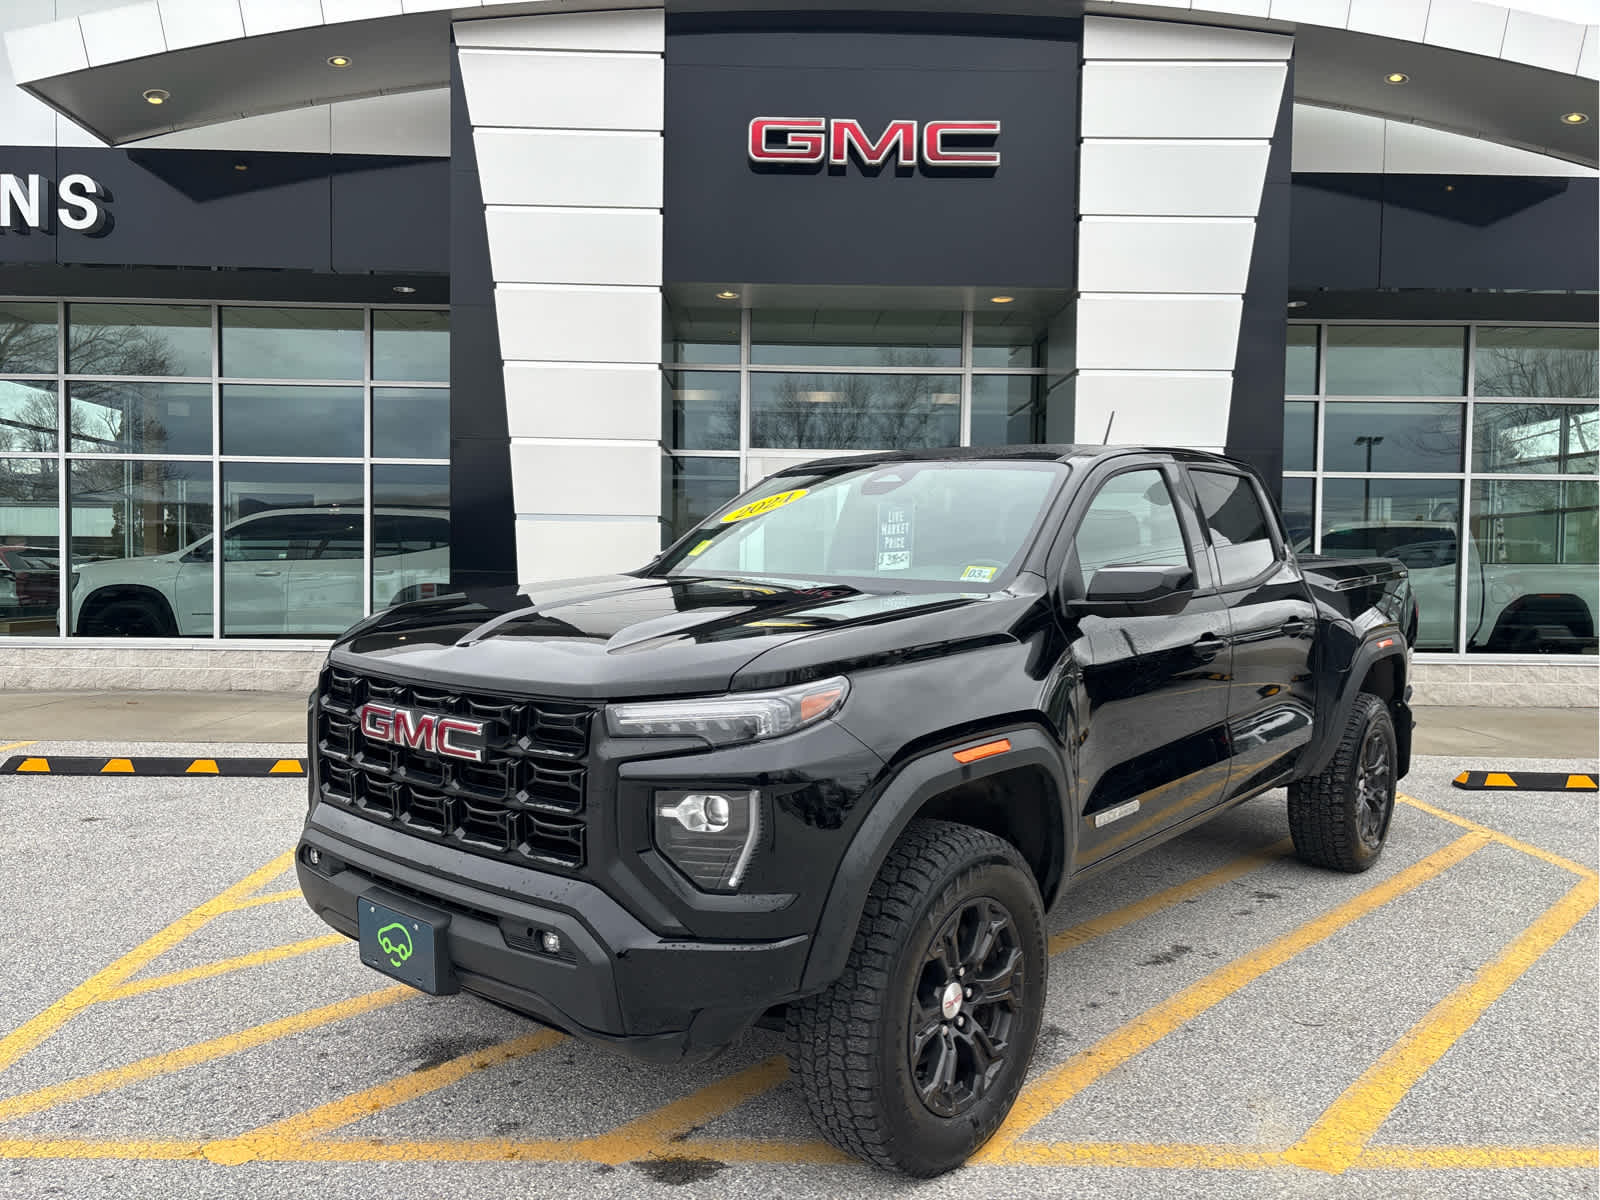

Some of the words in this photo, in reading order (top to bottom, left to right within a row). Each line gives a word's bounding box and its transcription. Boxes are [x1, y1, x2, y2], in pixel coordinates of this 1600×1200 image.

[748, 116, 1001, 167] GMC
[888, 511, 905, 522] LIVE
[881, 521, 909, 536] MARKET
[885, 536, 905, 549] PRICE
[360, 702, 482, 762] GMC
